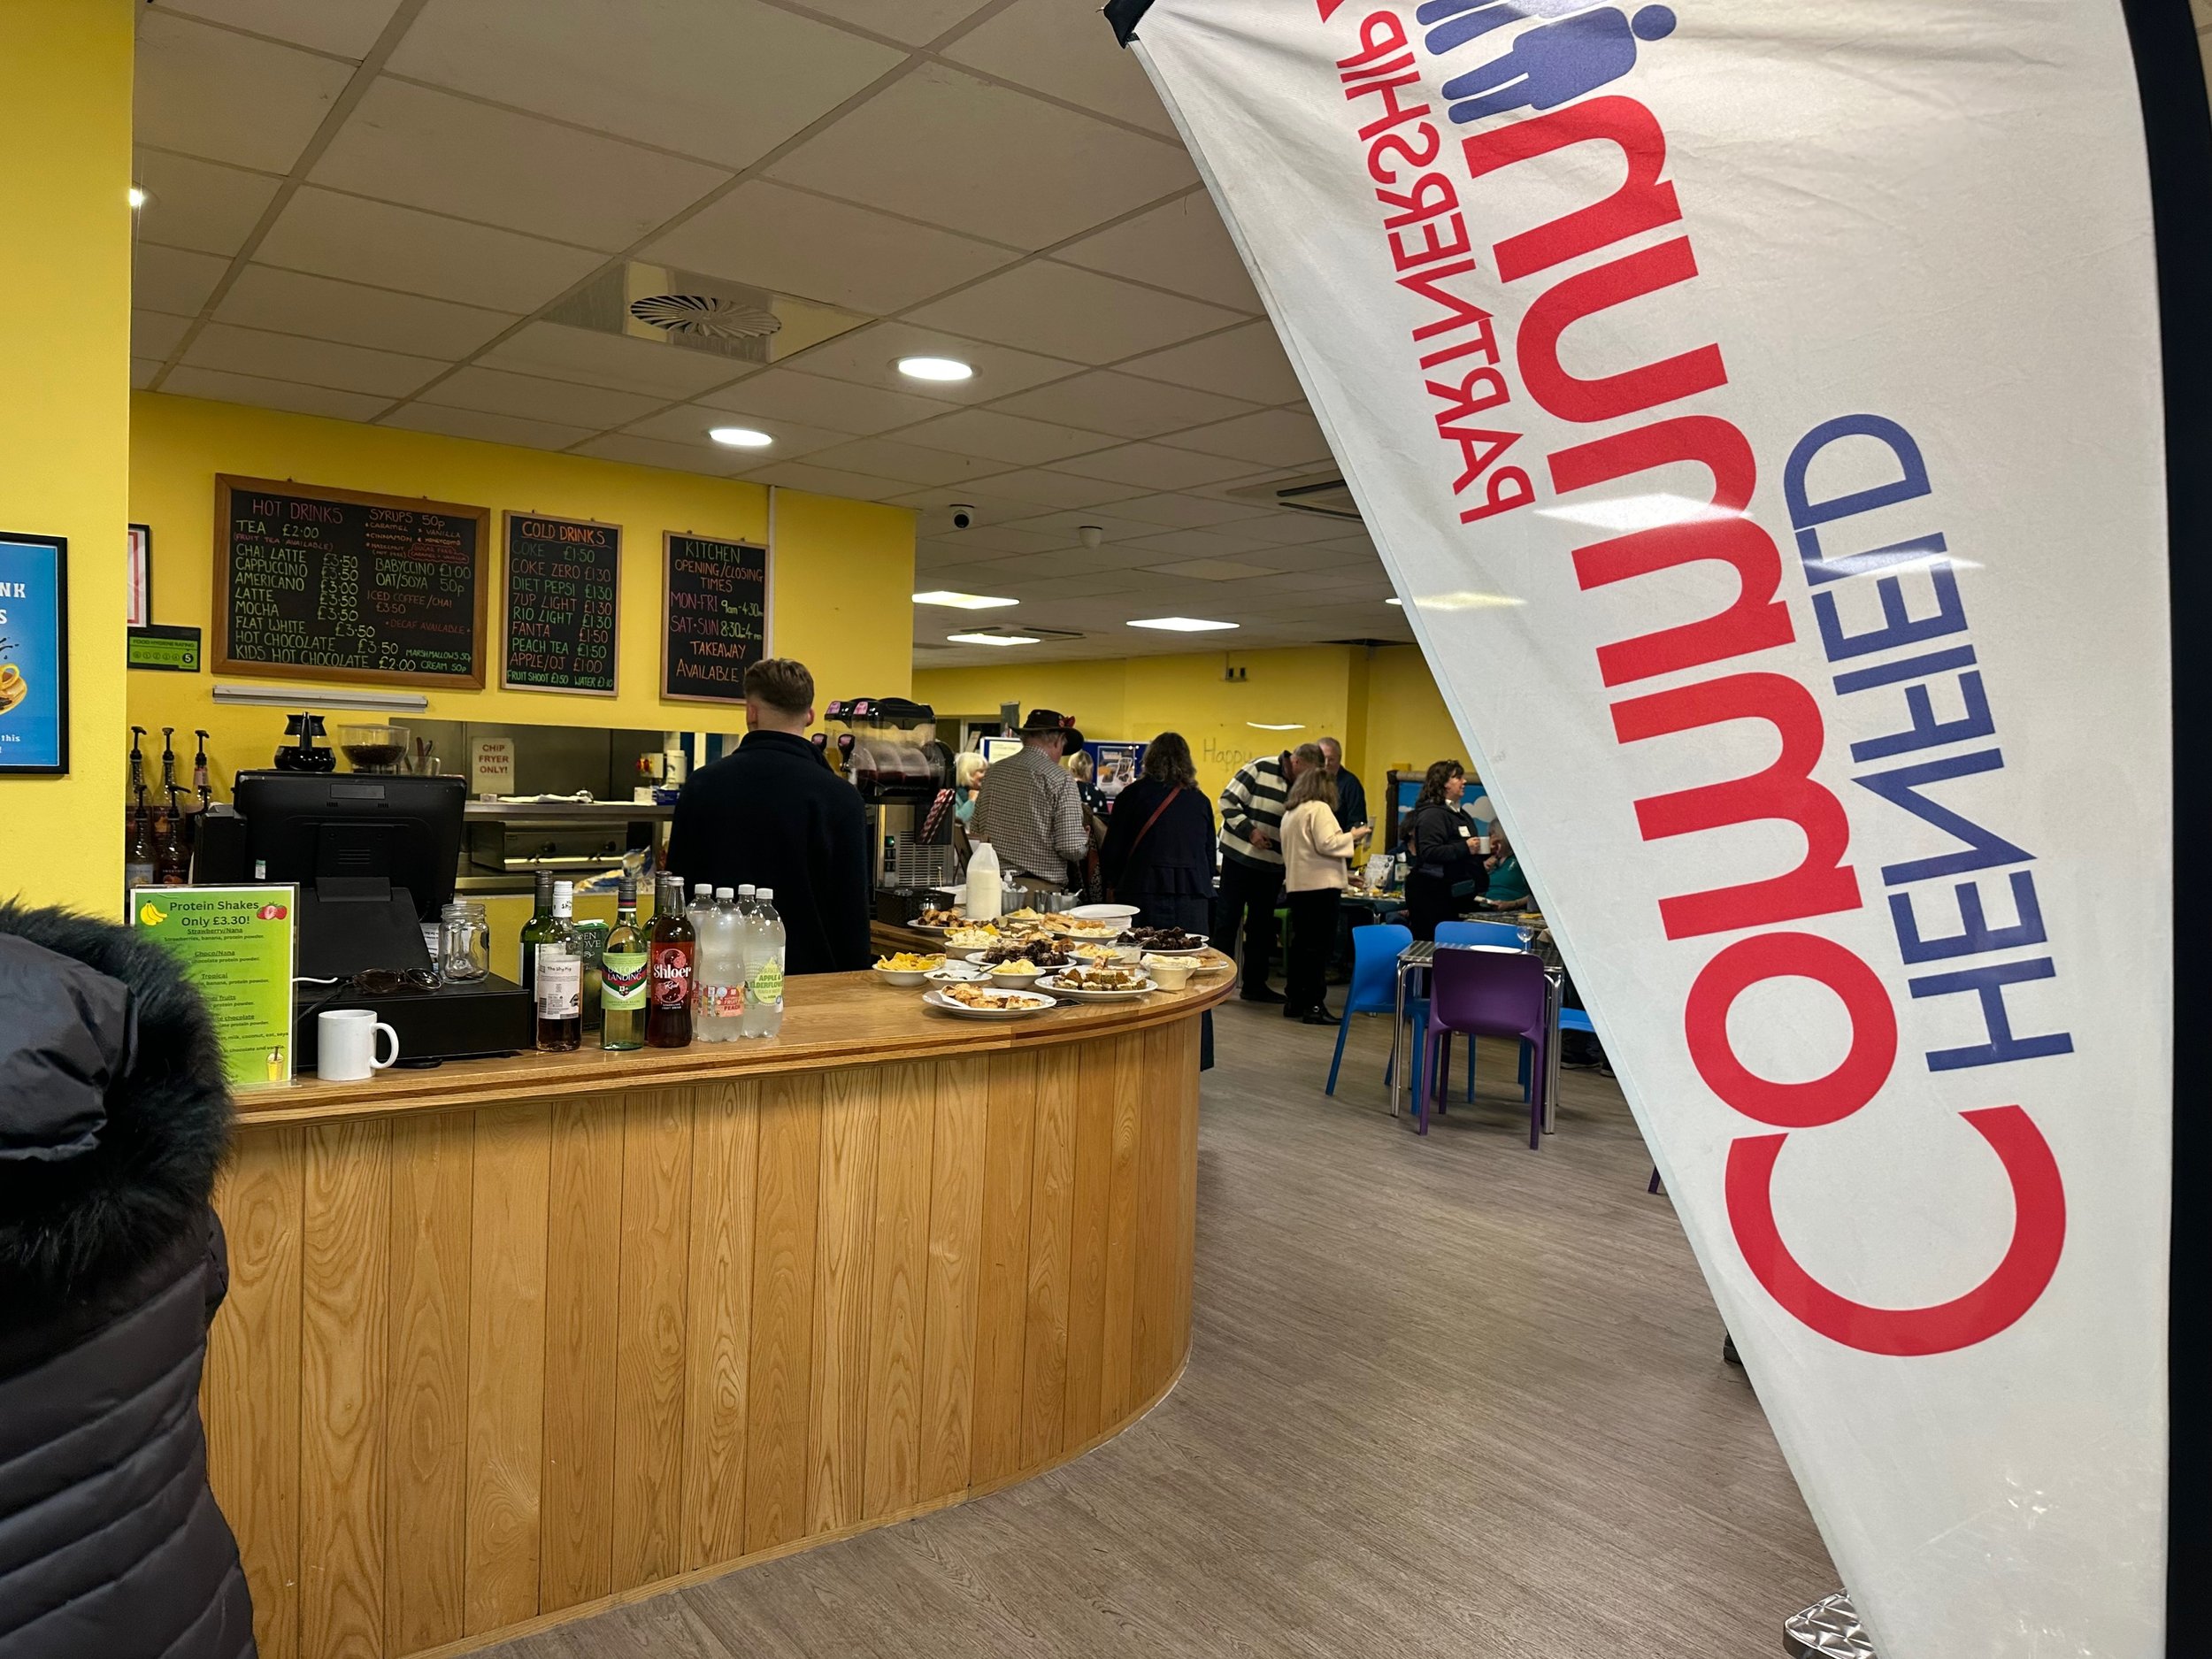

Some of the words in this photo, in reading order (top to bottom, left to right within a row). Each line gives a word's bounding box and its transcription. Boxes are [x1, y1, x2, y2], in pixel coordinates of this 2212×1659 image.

[252, 498, 281, 517] HOT
[290, 502, 343, 525] DRINKS
[369, 508, 413, 524] SYRUPS
[422, 515, 446, 530] 50p
[235, 519, 266, 534] TEA
[369, 522, 409, 532] CARAMEL
[521, 521, 556, 539] COLD
[559, 526, 605, 545] DRINKS
[370, 533, 412, 542] CINNAMON
[235, 543, 265, 558] CHAI
[270, 548, 307, 564] LATTE
[511, 539, 546, 557] COKE
[686, 541, 741, 564] KITCHEN
[235, 557, 308, 578] CAPPUCCINO
[375, 557, 435, 576] BABYCCINO
[511, 557, 546, 577] COKE
[551, 562, 581, 580] ZERO
[674, 559, 764, 583] OPENING/CLOSING
[234, 572, 305, 591] AMERICANO
[376, 572, 428, 589] OAT/SOYA
[440, 578, 465, 597] 50p
[512, 576, 541, 592] DIET
[544, 580, 575, 597] PEPSI
[700, 577, 733, 593] TIMES
[234, 587, 274, 602] LATTE
[367, 589, 390, 601] ICED
[513, 592, 537, 607] 7UP
[541, 595, 578, 611] LIGHT
[671, 592, 718, 612] MON-FRI
[234, 601, 280, 617] MOCHA
[513, 606, 534, 621] RIO
[538, 609, 573, 626] LIGHT
[235, 616, 263, 631] FLAT
[269, 618, 307, 634] WHITE
[390, 619, 419, 629] DECAF
[420, 621, 465, 634] AVAILABLE
[511, 620, 550, 637] FANTA
[235, 630, 260, 644] HOT
[264, 633, 336, 652] CHOCOLATE
[512, 637, 546, 653] PEACH
[549, 640, 569, 655] TEA
[689, 641, 746, 659] TAKEAWAY
[185, 654, 192, 663] 5
[235, 644, 266, 661] KIDS
[272, 648, 296, 664] HOT
[301, 650, 371, 669] CHOCOLATE
[405, 649, 459, 661] MARSHMALLOWS
[510, 652, 566, 672] APPLE/OJ
[420, 660, 448, 671] CREAM
[451, 663, 467, 672] 50p
[676, 658, 740, 683] AVAILABLE
[507, 670, 526, 680] FRUIT
[527, 672, 549, 683] SHOOT
[574, 676, 596, 687] WATER
[2, 733, 21, 742] this
[170, 902, 214, 911] Protein
[217, 901, 259, 910] Shakes
[181, 917, 210, 928] Only
[213, 916, 250, 926] £3.30!
[653, 964, 692, 979] Shloer
